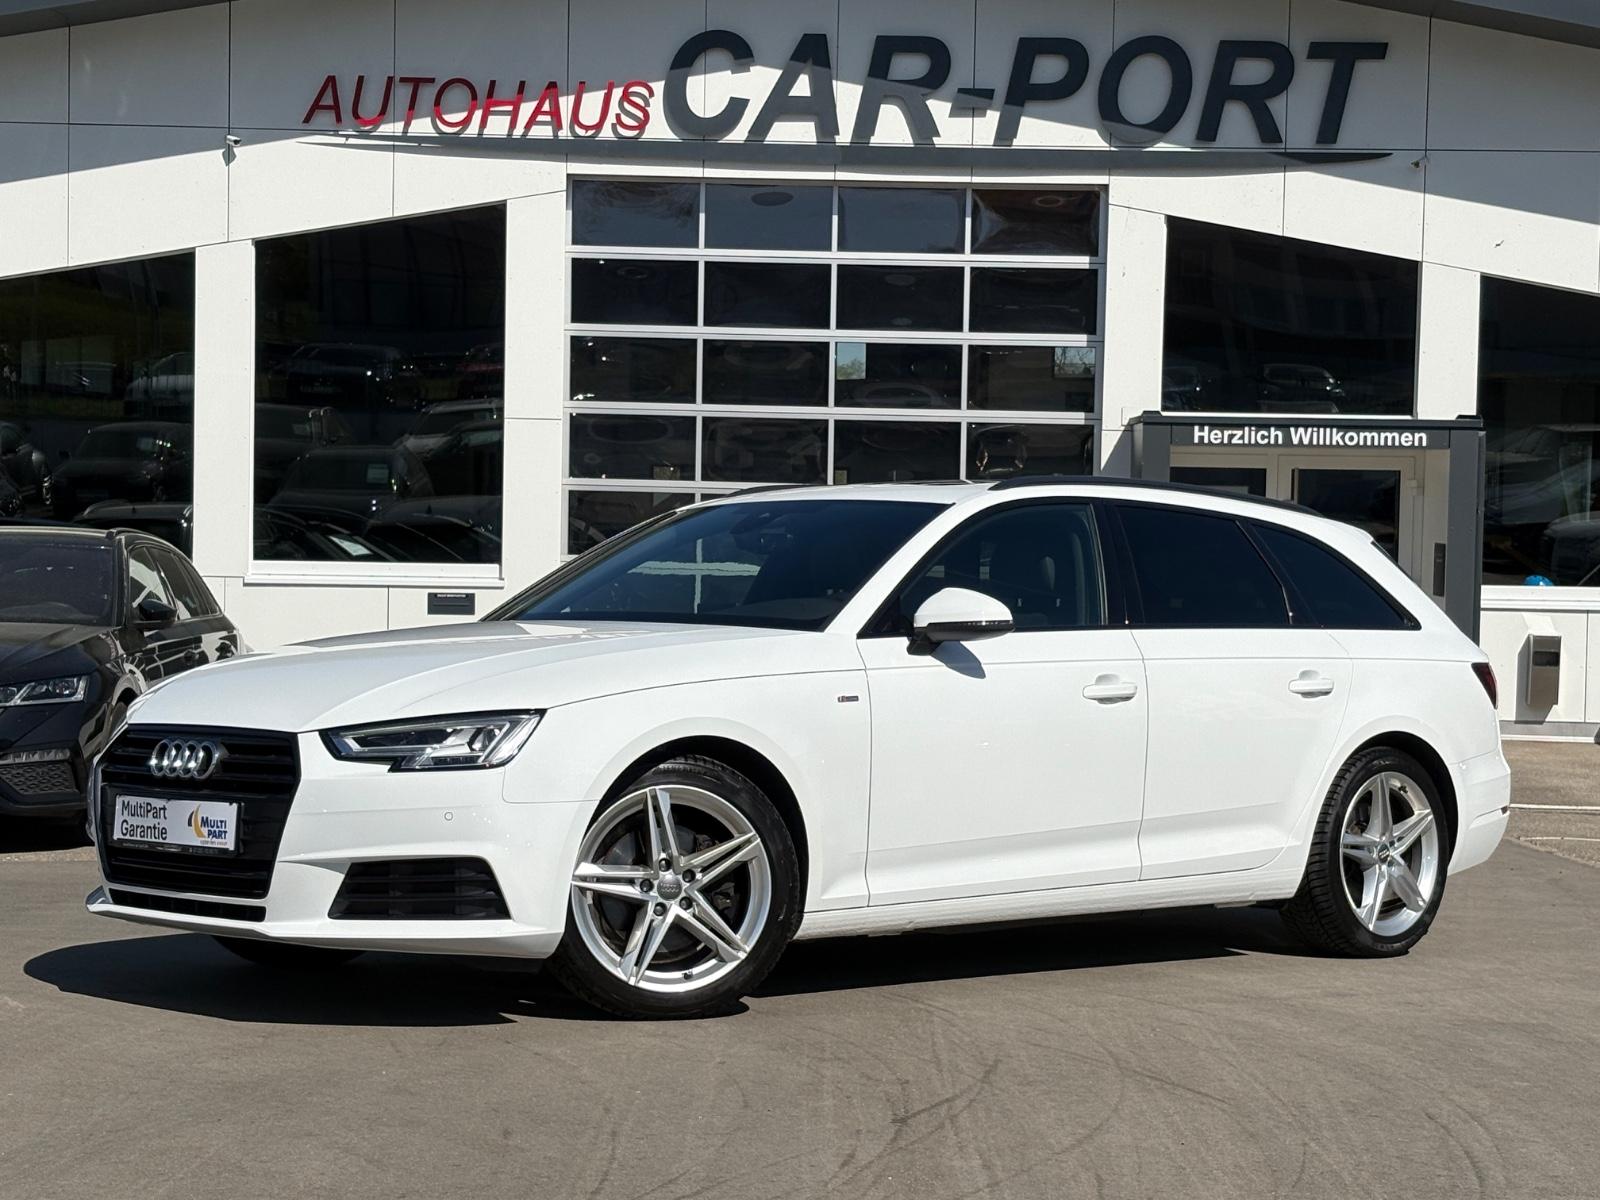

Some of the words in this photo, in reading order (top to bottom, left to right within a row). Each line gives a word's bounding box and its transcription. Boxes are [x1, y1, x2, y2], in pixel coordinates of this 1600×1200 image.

[302, 74, 654, 133] AUTOHAUS
[663, 29, 1389, 145] CAR-PORT
[1193, 425, 1283, 445] Herzlich
[1290, 426, 1428, 447] Willkommen
[121, 799, 168, 820] MultiPart
[120, 818, 168, 841] Garantie
[200, 815, 228, 830] MULTI
[207, 829, 228, 840] PART
